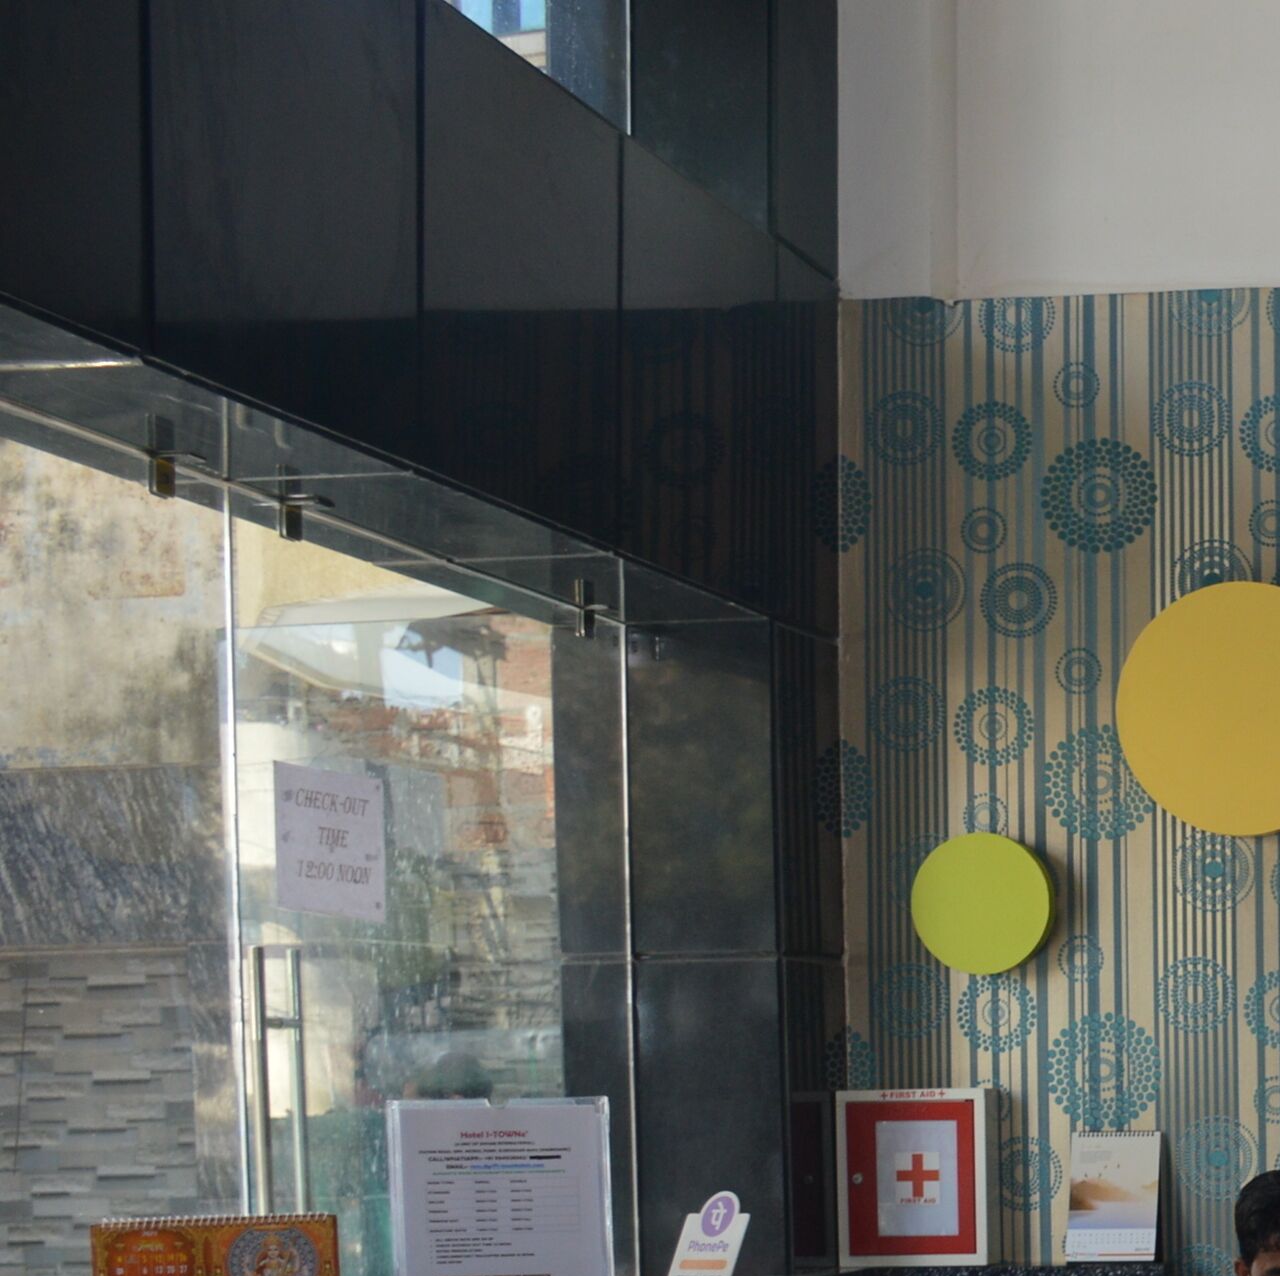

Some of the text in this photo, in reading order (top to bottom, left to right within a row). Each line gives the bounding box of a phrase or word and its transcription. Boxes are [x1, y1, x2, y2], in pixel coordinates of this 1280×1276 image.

[295, 788, 370, 817] CHECK-OUT
[318, 826, 349, 848] TIME
[297, 860, 373, 884] 12:00 NOON
[920, 1090, 936, 1098] AID
[460, 1131, 484, 1139] Hotel
[687, 1240, 729, 1252] PhonePe
